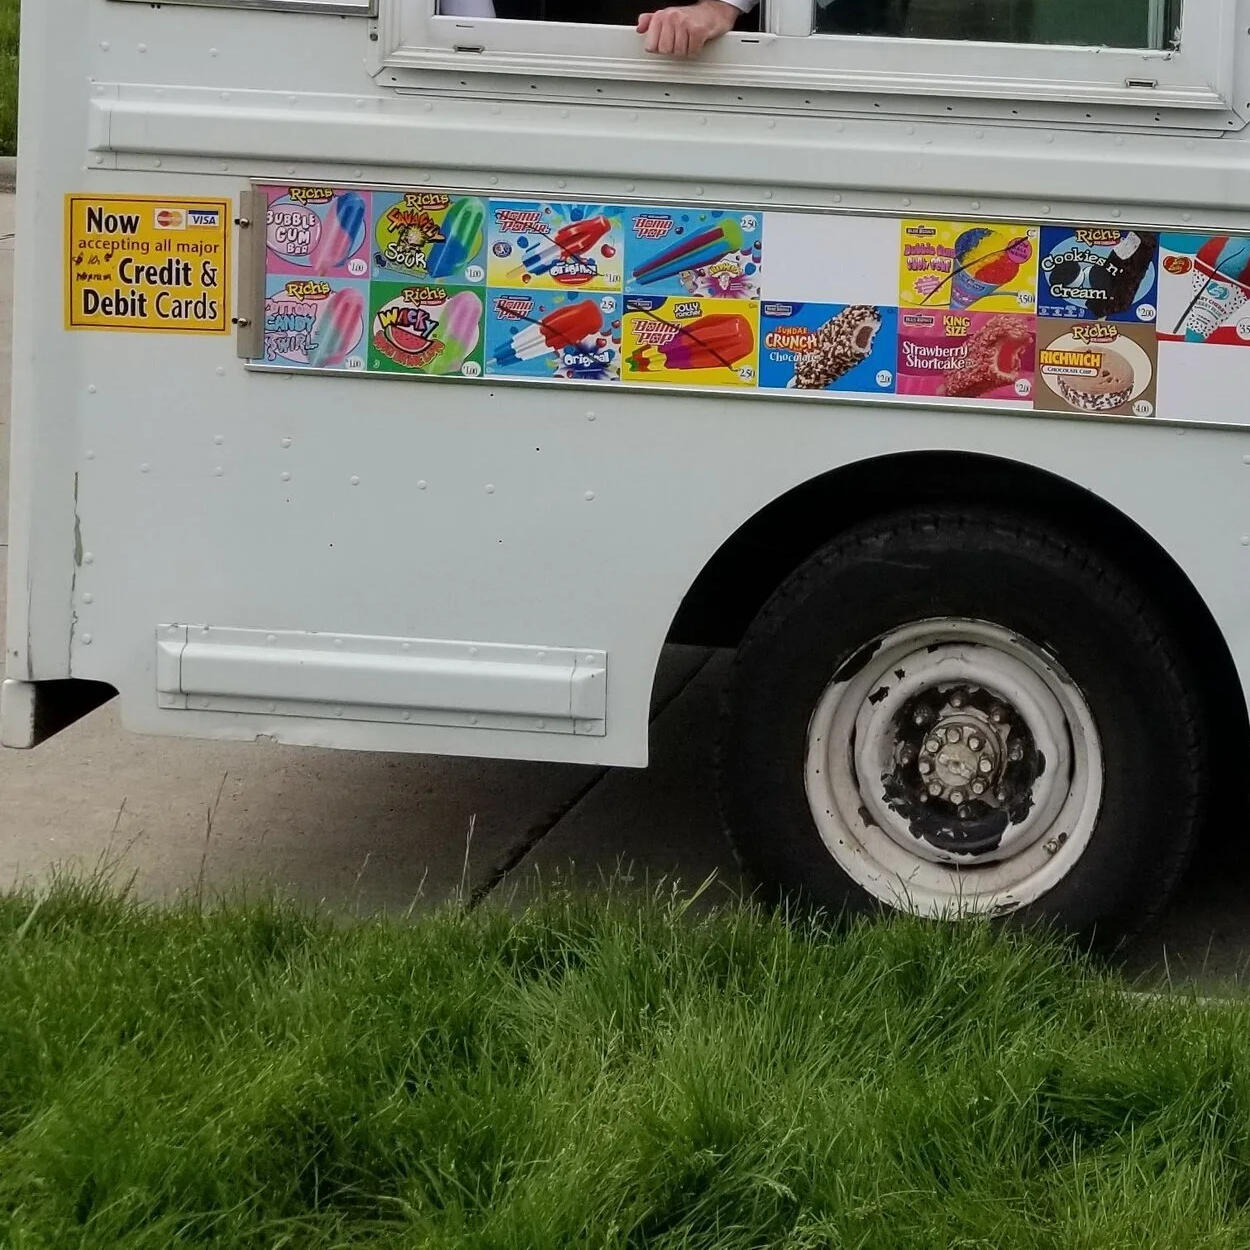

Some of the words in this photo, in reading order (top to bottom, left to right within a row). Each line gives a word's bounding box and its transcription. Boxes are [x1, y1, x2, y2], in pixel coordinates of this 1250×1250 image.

[86, 207, 139, 234] Now
[192, 216, 216, 225] VISA
[267, 211, 315, 230] BUBBLE
[276, 227, 310, 245] GUM
[79, 238, 150, 254] accepting
[155, 239, 171, 252] all
[176, 241, 220, 257] major
[385, 242, 427, 269] SOUR
[1041, 248, 1107, 271] Cookies
[119, 258, 192, 286] Credit
[201, 261, 217, 287] &
[1050, 284, 1108, 300] Cream
[83, 289, 147, 317] Debit
[156, 291, 217, 319] Cards
[675, 302, 699, 313] JOLLY
[265, 315, 315, 332] CANDY
[378, 307, 439, 340] WACKY
[943, 316, 971, 328] KING
[637, 333, 675, 345] POP
[945, 327, 967, 336] SIZE
[265, 333, 319, 361] SWIRL
[902, 341, 968, 358] Strawberry
[564, 352, 610, 366] Original
[906, 354, 965, 370] Shortcake
[1040, 351, 1101, 367] RICHWICH
